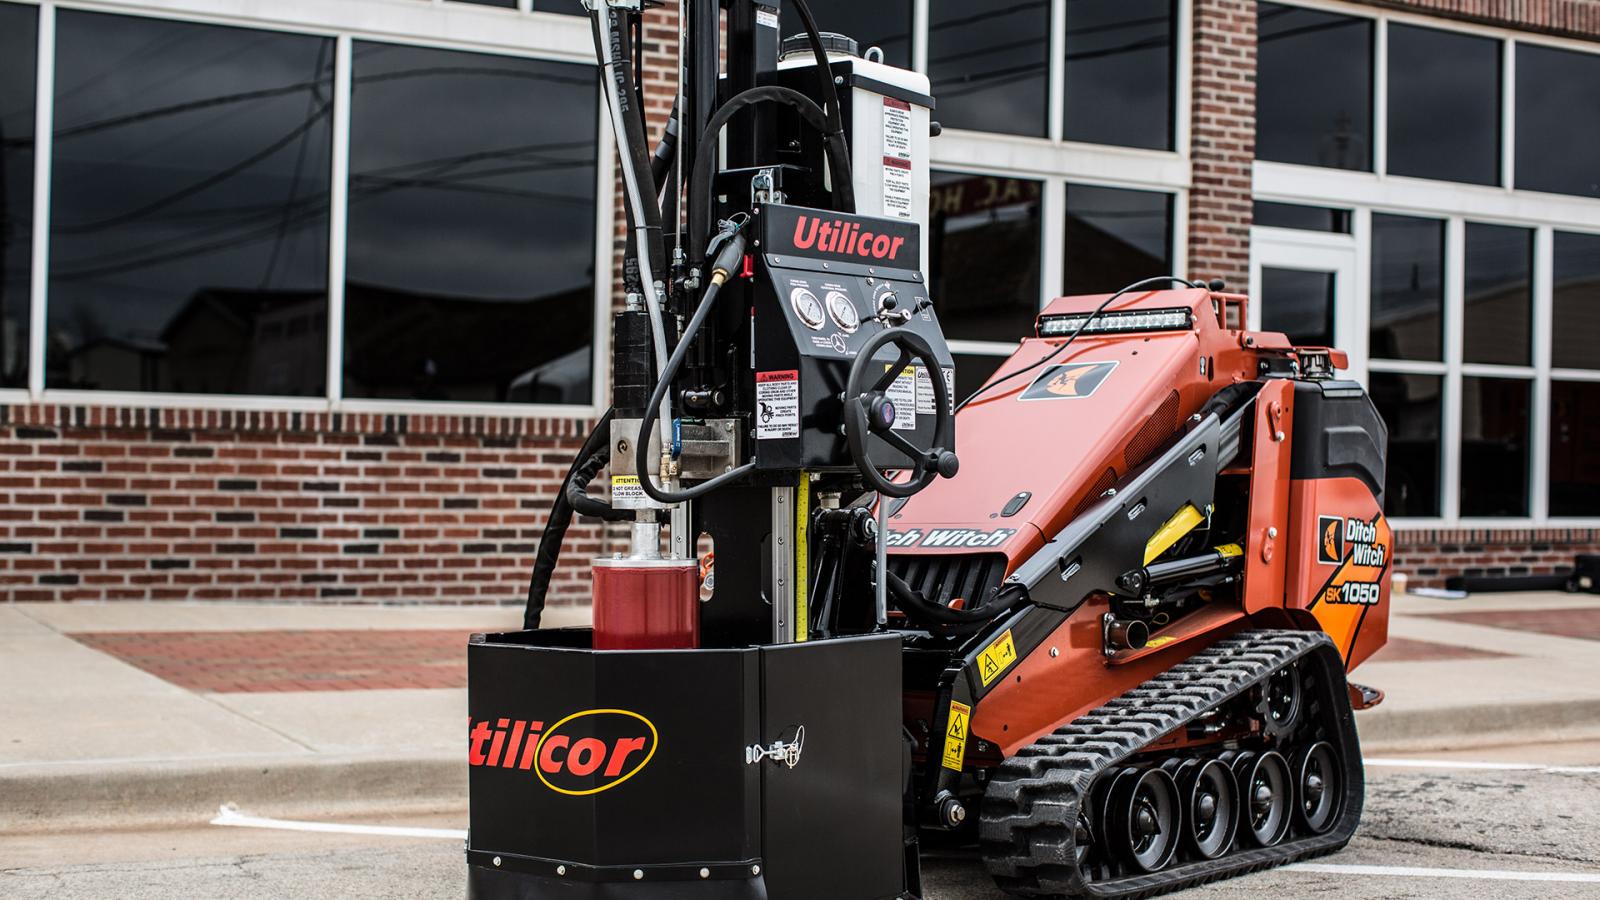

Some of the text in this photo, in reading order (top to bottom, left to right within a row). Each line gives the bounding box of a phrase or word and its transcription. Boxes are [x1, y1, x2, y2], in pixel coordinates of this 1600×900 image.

[793, 215, 904, 260] Utilicor
[920, 529, 1009, 547] Witch
[1346, 518, 1376, 542] Ditch
[1353, 543, 1384, 566] Witch
[467, 716, 646, 777] tilicor
